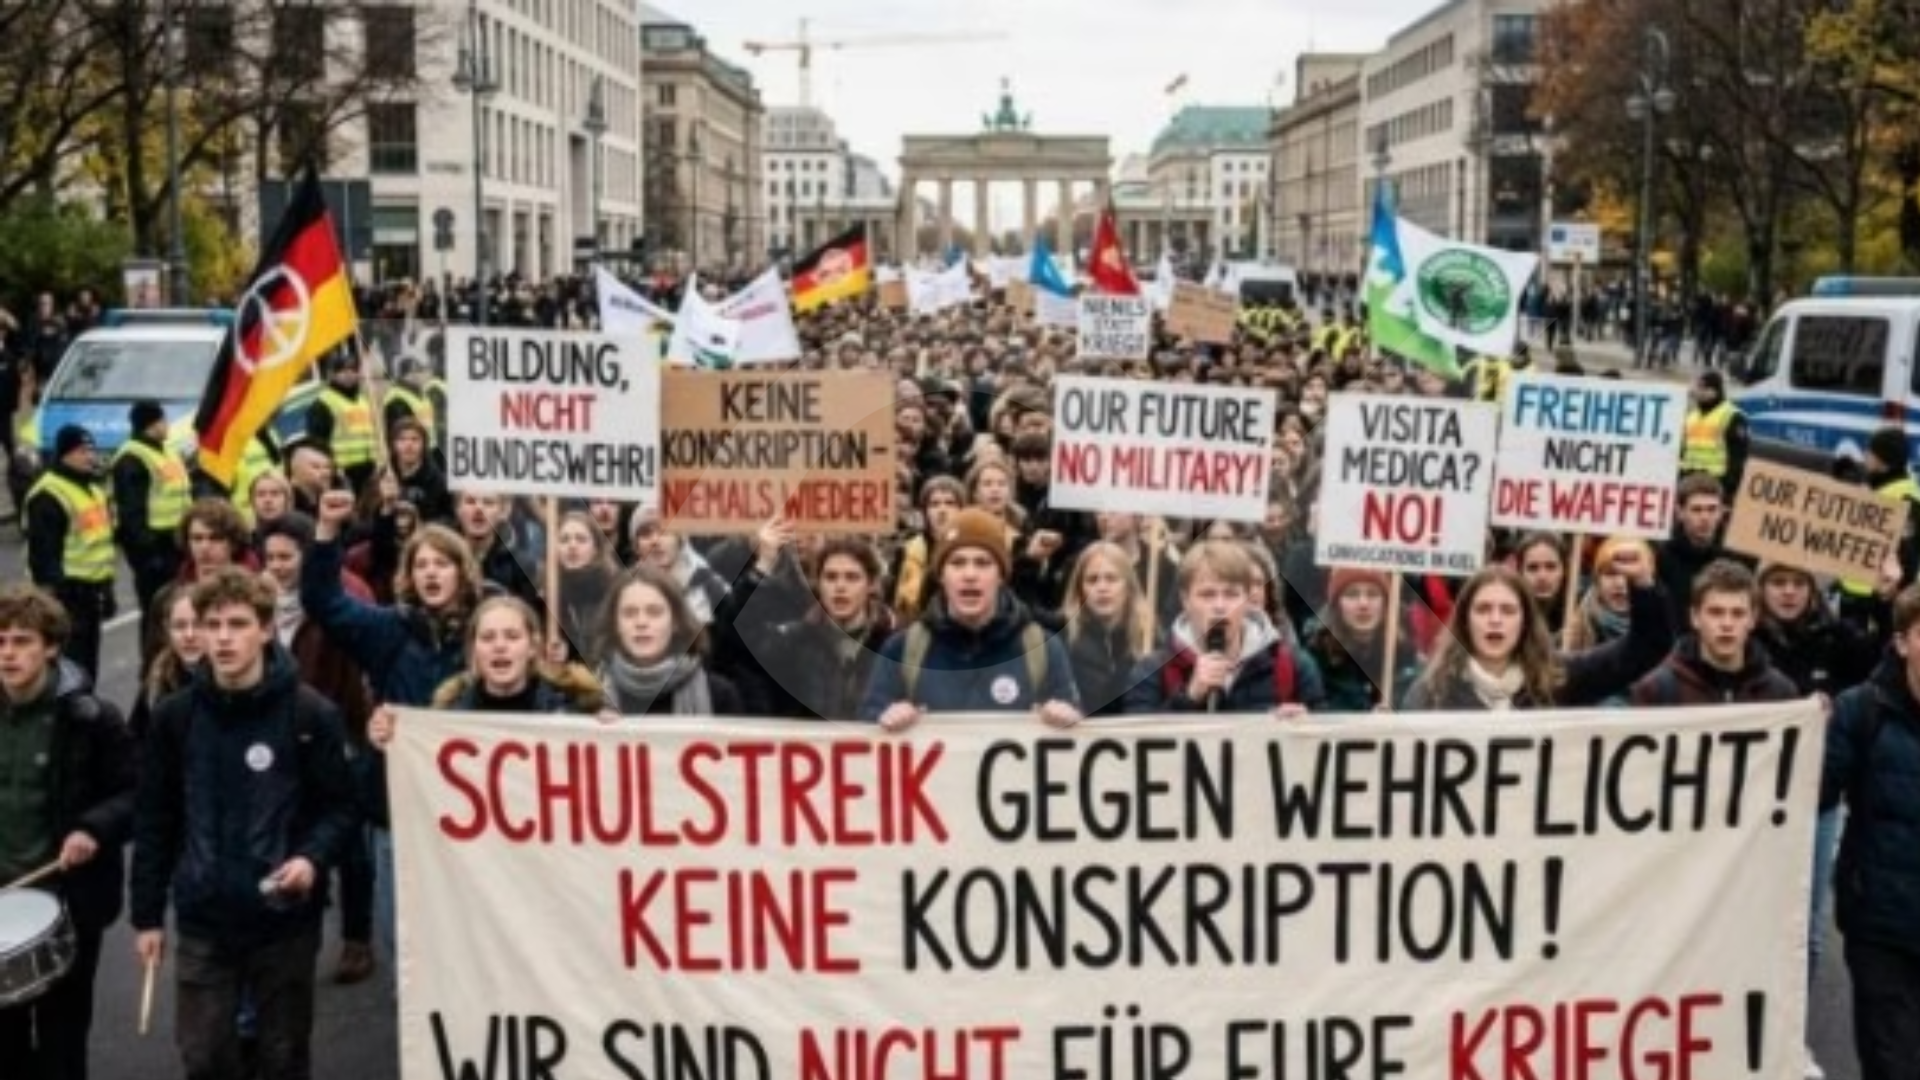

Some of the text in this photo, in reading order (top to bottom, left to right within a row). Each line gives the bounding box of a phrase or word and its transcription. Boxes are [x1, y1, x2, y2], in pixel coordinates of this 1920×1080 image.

[469, 337, 628, 392] BILDUNG,
[501, 394, 597, 432] NICHT
[721, 382, 820, 422] KEINE
[1062, 388, 1265, 446] OUR FUTURE,
[1360, 404, 1462, 447] VISITA
[1513, 384, 1671, 444] FREIHEIT,
[452, 436, 654, 487] BUNDESWEHR!
[1055, 443, 1265, 497] NO MILITARY!
[1342, 447, 1480, 494] MEDICA?
[1544, 440, 1633, 475] NICHT
[662, 479, 889, 521] NIEMALS WIEDER!
[1497, 478, 1673, 529] DIE WAFFE!
[1749, 473, 1798, 510] OUR
[1362, 490, 1444, 545] NO!
[1759, 512, 1797, 545] NO
[437, 726, 1800, 848] SCHULSTREIK GEGEN WEHRFLICHT!
[619, 867, 857, 975] KEINE
[430, 1012, 566, 1080] WIR
